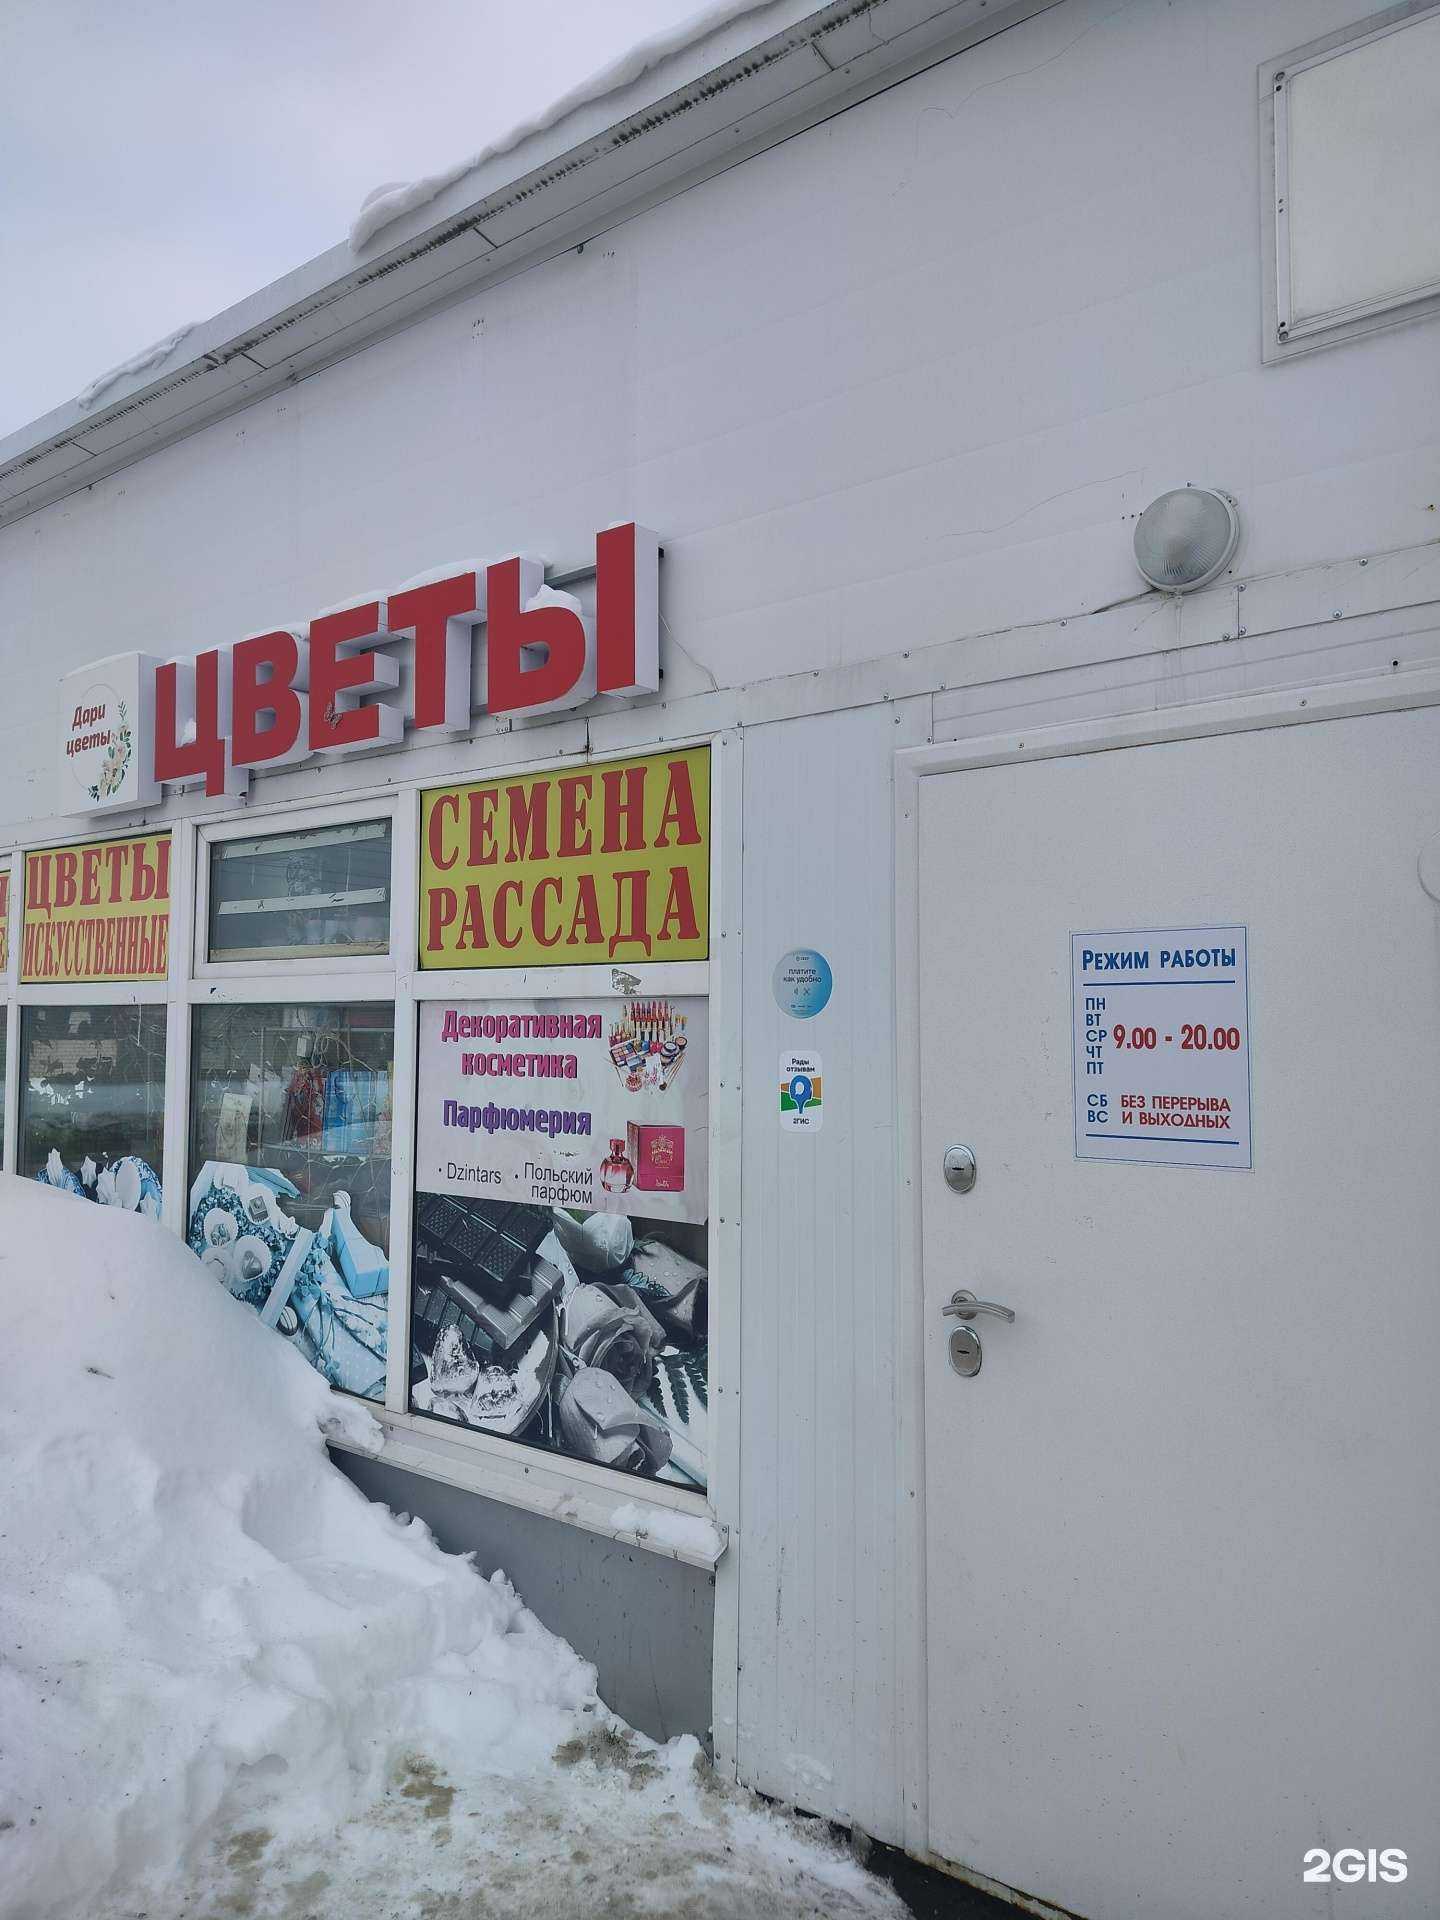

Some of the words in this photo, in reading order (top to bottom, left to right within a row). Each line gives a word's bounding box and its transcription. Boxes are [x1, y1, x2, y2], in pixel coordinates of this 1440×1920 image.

[154, 522, 636, 796] ЦВЕТЫ
[72, 703, 106, 731] Дари
[66, 729, 110, 757] цветы
[428, 760, 702, 872] СЕМЕНА
[27, 840, 171, 919] ЦВЕТЫ
[427, 866, 701, 958] РАССАДА
[22, 915, 168, 976] ИСКУССТВЕННЫЕ
[796, 975, 822, 984] удобно
[1085, 998, 1106, 1010] ПН
[441, 1011, 602, 1043] Декоративная
[1086, 1014, 1101, 1026] ВТ
[1086, 1030, 1107, 1043] СР
[1113, 1024, 1157, 1050] 9.00
[1181, 1024, 1240, 1050] 20.00
[791, 1058, 809, 1066] Рады
[1086, 1046, 1102, 1058] ЧТ
[461, 1053, 577, 1079] косметика
[1086, 1062, 1104, 1074] ПТ
[1087, 1094, 1108, 1107] СБ
[1121, 1095, 1146, 1108] БЕЗ
[1152, 1095, 1231, 1112] ПЕРЕРЫВА
[443, 1100, 592, 1138] Парфюмерия
[1088, 1110, 1109, 1123] ВС
[1122, 1112, 1132, 1124] И
[1139, 1112, 1231, 1129] ВЫХОДНЫХ
[446, 1163, 502, 1184] Dzintars
[524, 1162, 593, 1185] Польский
[531, 1185, 592, 1204] парфюм
